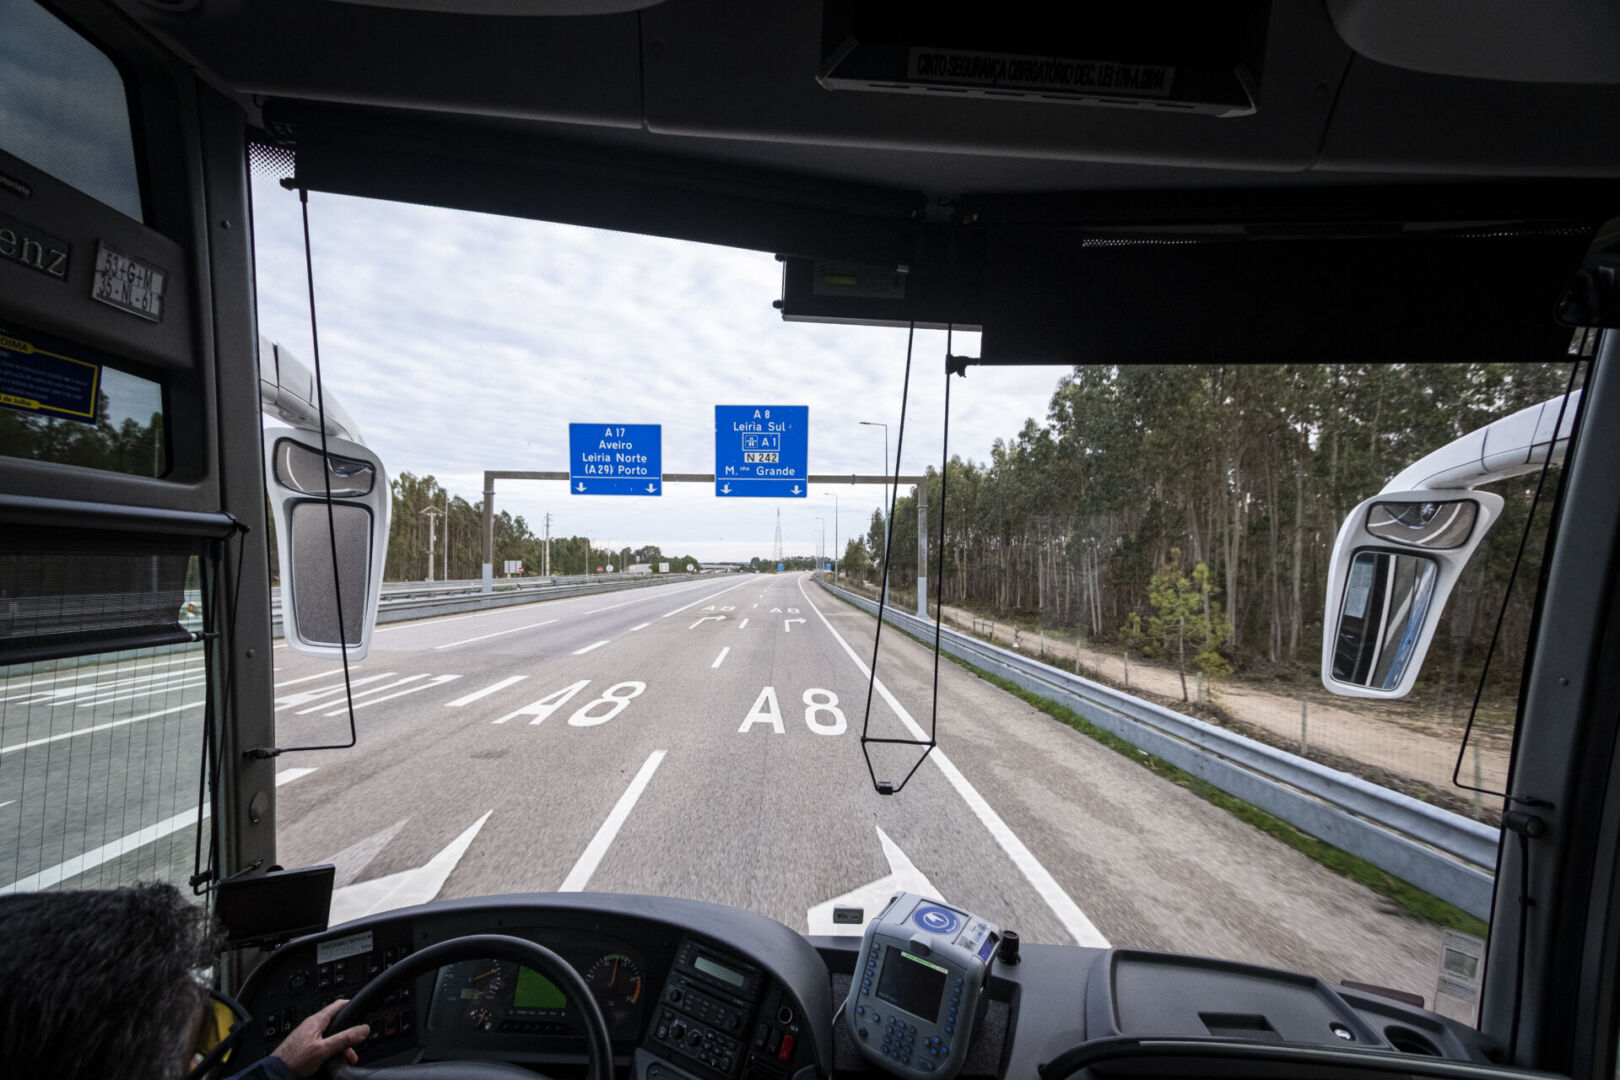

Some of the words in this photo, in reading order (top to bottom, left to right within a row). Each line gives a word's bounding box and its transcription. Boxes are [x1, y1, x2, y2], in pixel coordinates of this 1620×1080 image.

[733, 421, 762, 431] Leiria
[768, 421, 786, 431] Sul
[599, 440, 632, 450] Aveiro
[582, 452, 611, 462] Leiria
[616, 453, 647, 463] Norte
[618, 465, 647, 475] Porto
[756, 465, 795, 476] Grande
